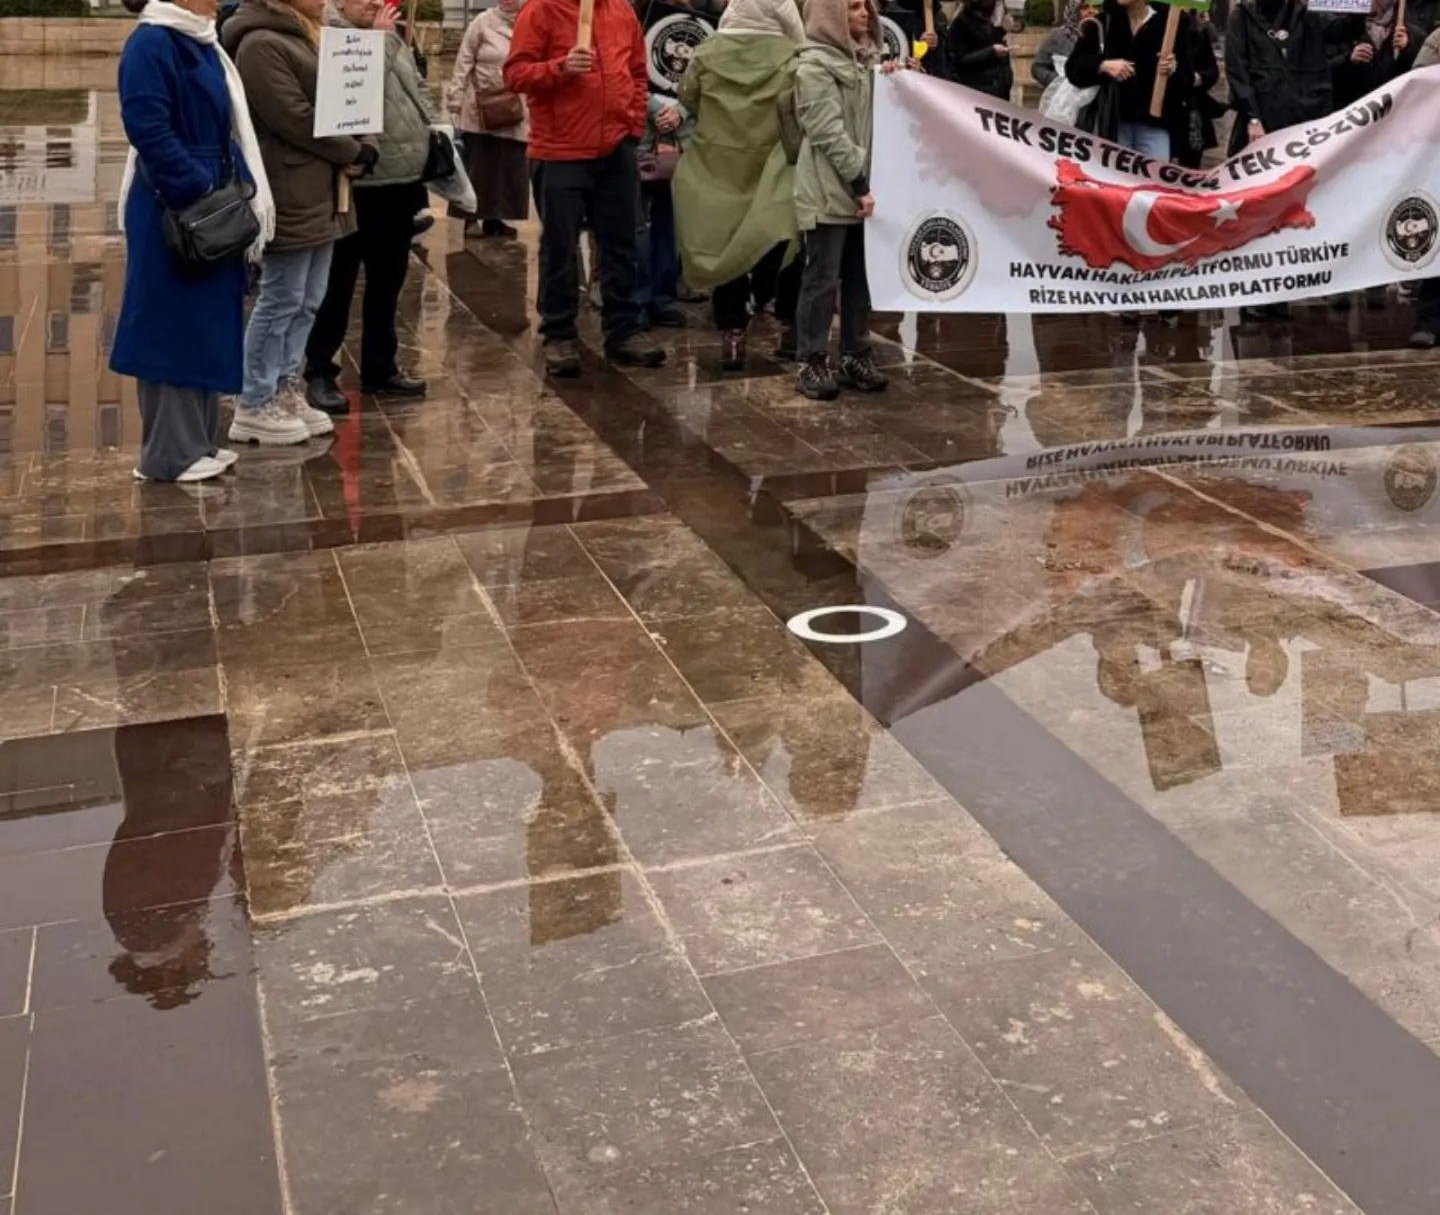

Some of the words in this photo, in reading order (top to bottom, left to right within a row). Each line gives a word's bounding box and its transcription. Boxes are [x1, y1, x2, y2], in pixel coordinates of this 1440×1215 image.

[974, 106, 1033, 147] TEK
[1038, 126, 1094, 162] SES
[1099, 143, 1159, 179] TEK
[1224, 147, 1285, 181] TEK
[1285, 92, 1394, 160] ÇÖZÜM
[1009, 261, 1089, 281] HAYVAN
[1091, 268, 1169, 285] HAKLARI
[1170, 251, 1274, 278] PLATFORMU
[1275, 240, 1349, 266] TÜRKİYE
[1029, 285, 1067, 304] RİZE
[1069, 290, 1147, 305] HAYVAN
[1149, 283, 1226, 303] HAKLARI
[1228, 270, 1332, 296] PLATFORMU
